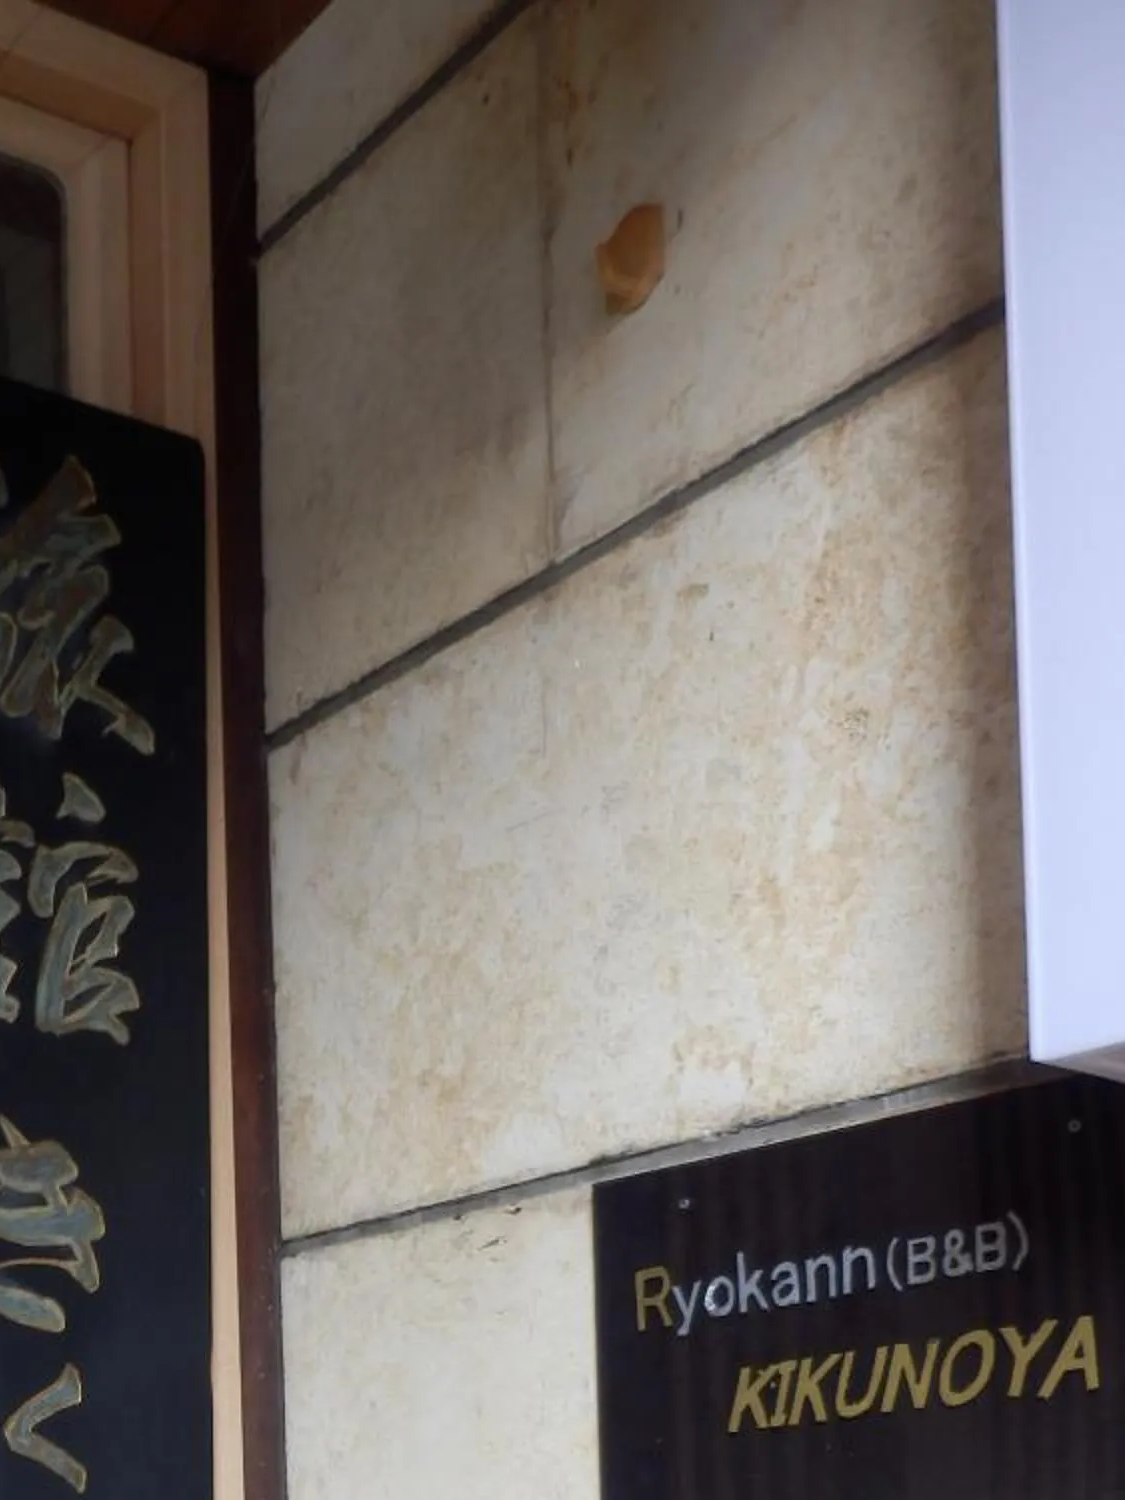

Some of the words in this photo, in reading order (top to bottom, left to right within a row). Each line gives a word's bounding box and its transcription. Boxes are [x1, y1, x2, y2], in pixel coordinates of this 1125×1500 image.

[633, 1244, 877, 1337] Ryokann
[886, 1210, 1029, 1292] (B&B)
[728, 1315, 1101, 1433] KIKUNOYA
